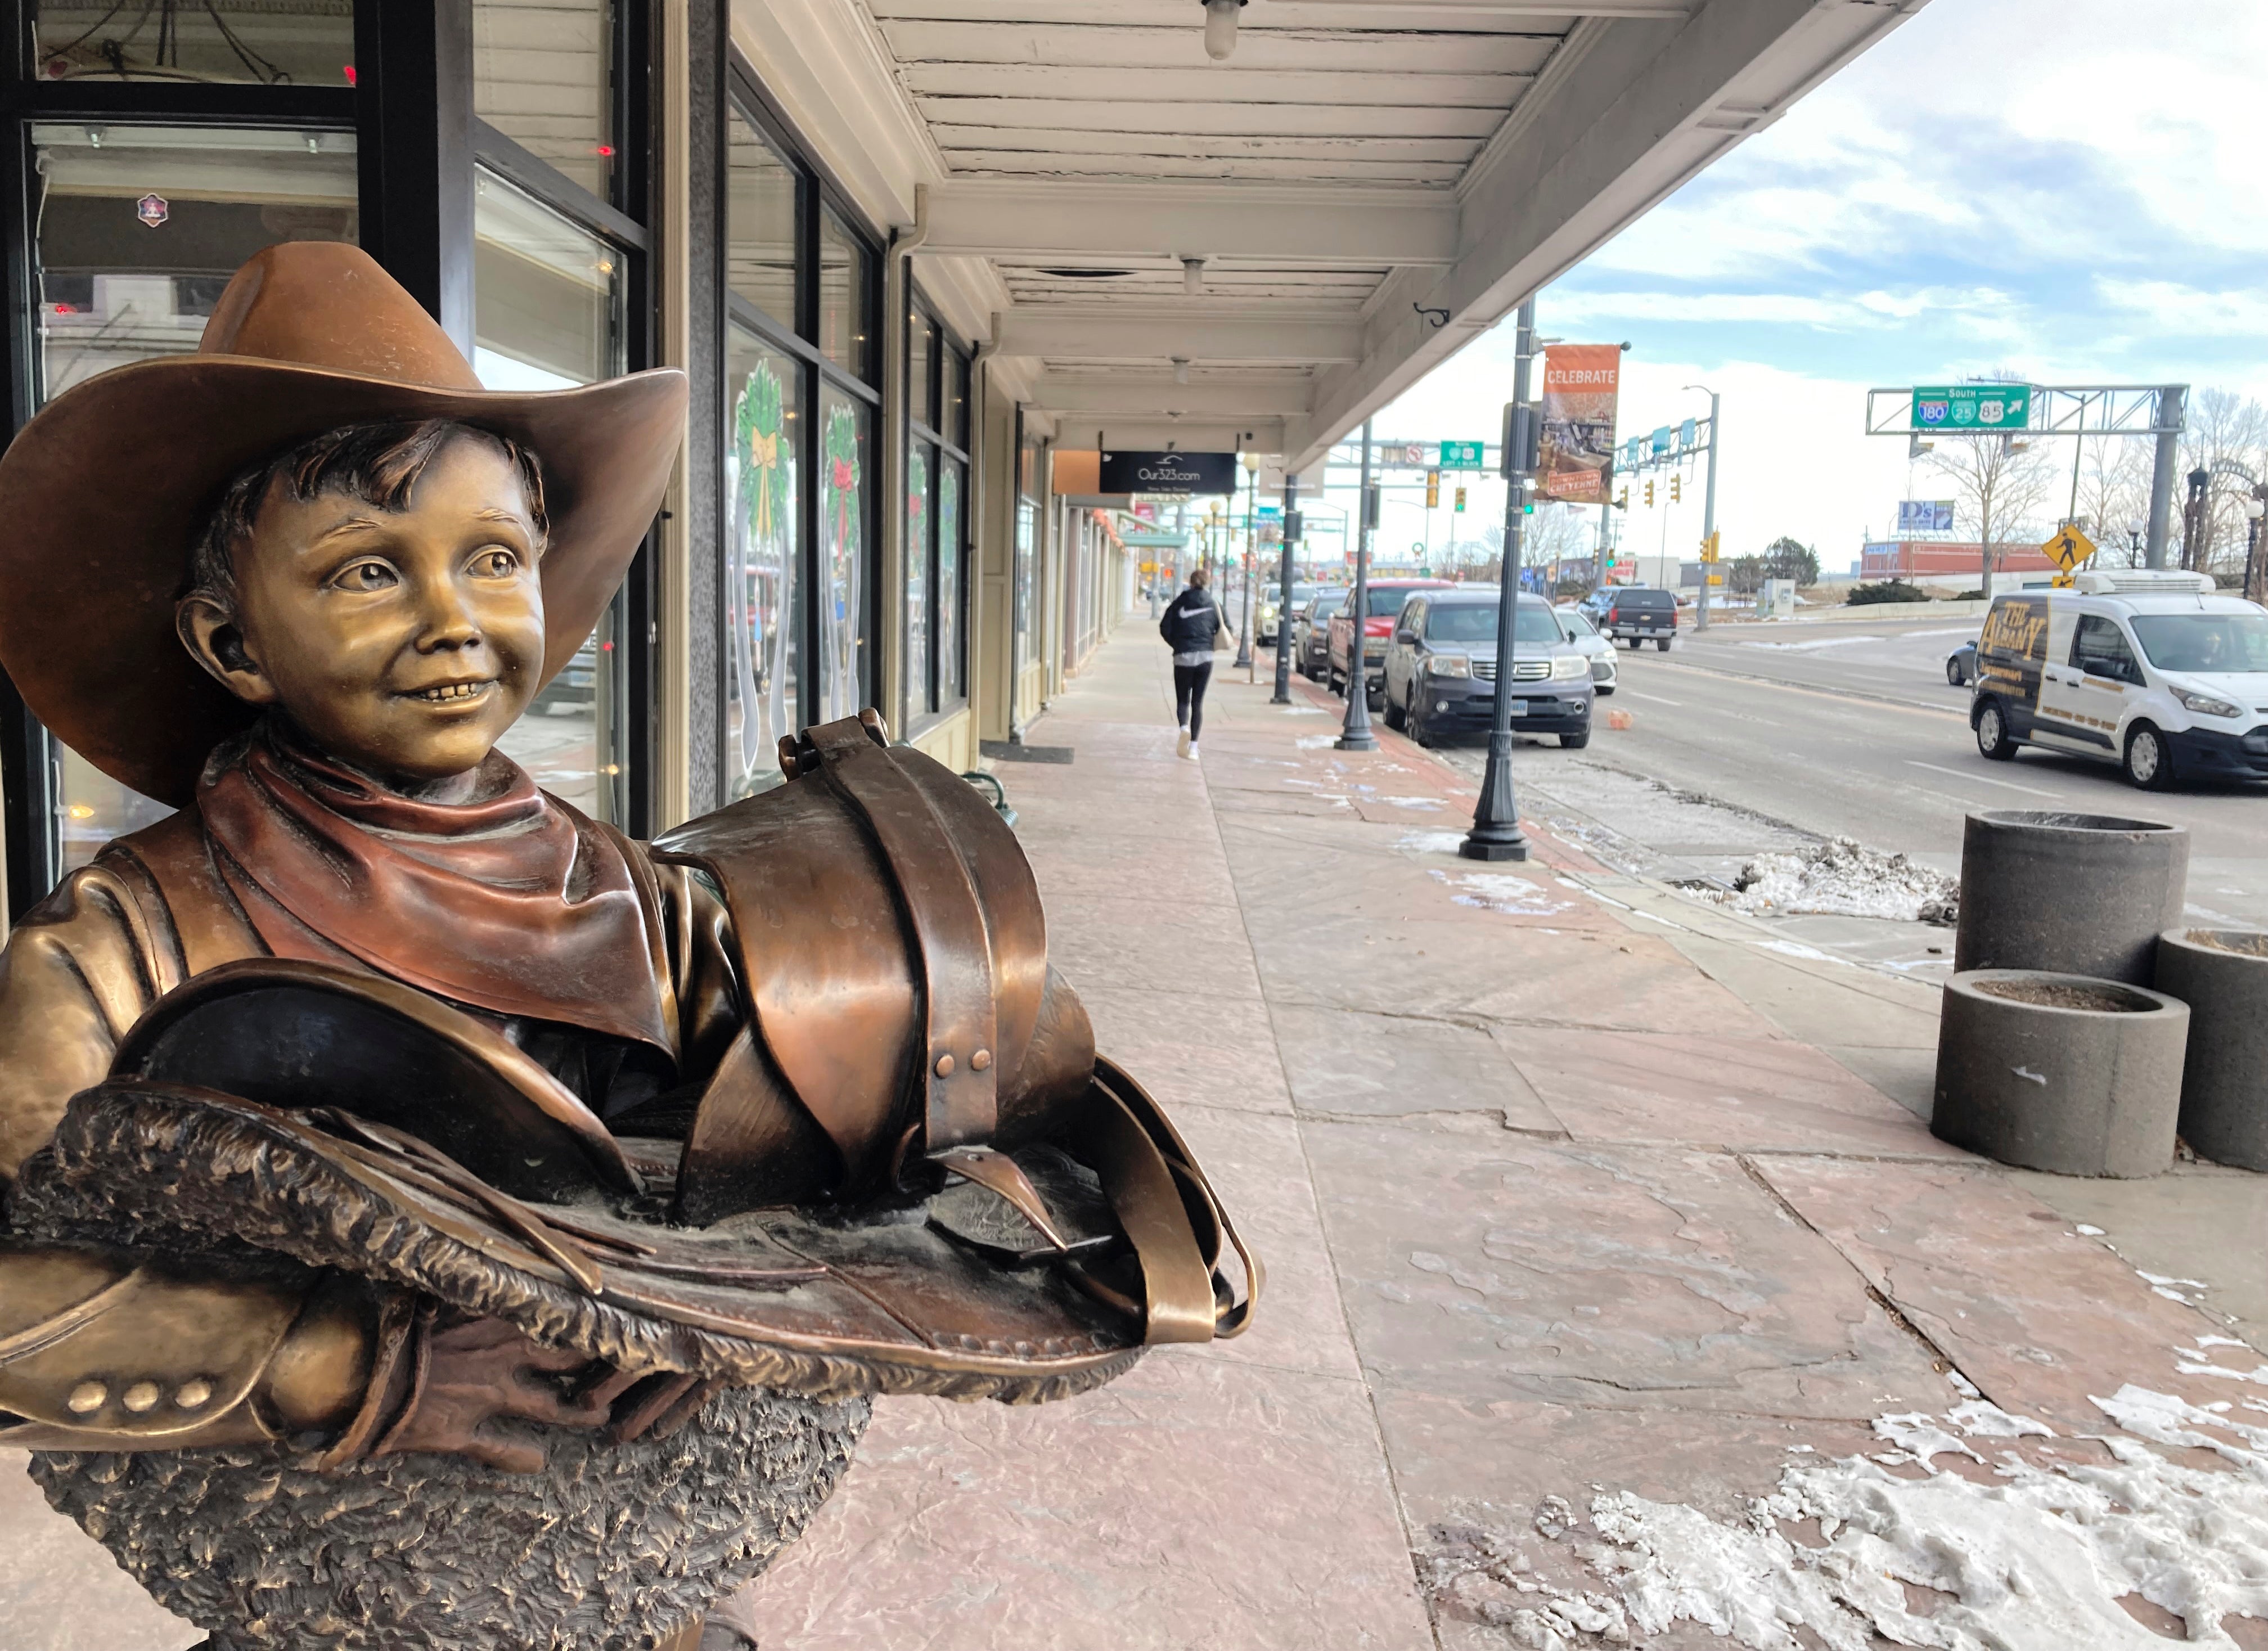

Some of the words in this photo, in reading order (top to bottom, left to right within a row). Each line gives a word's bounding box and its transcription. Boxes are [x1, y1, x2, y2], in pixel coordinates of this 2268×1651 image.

[1547, 370, 1616, 384] CELEBRATE
[1923, 406, 1945, 420] 180
[1955, 408, 1972, 420] 25
[1982, 405, 2001, 418] 85
[1138, 468, 1200, 480] Our323.com
[1550, 473, 1599, 483] DOWNTOWN
[1550, 478, 1599, 493] CHEYENNE
[1903, 502, 1932, 518] D's
[2003, 601, 2030, 627] THE
